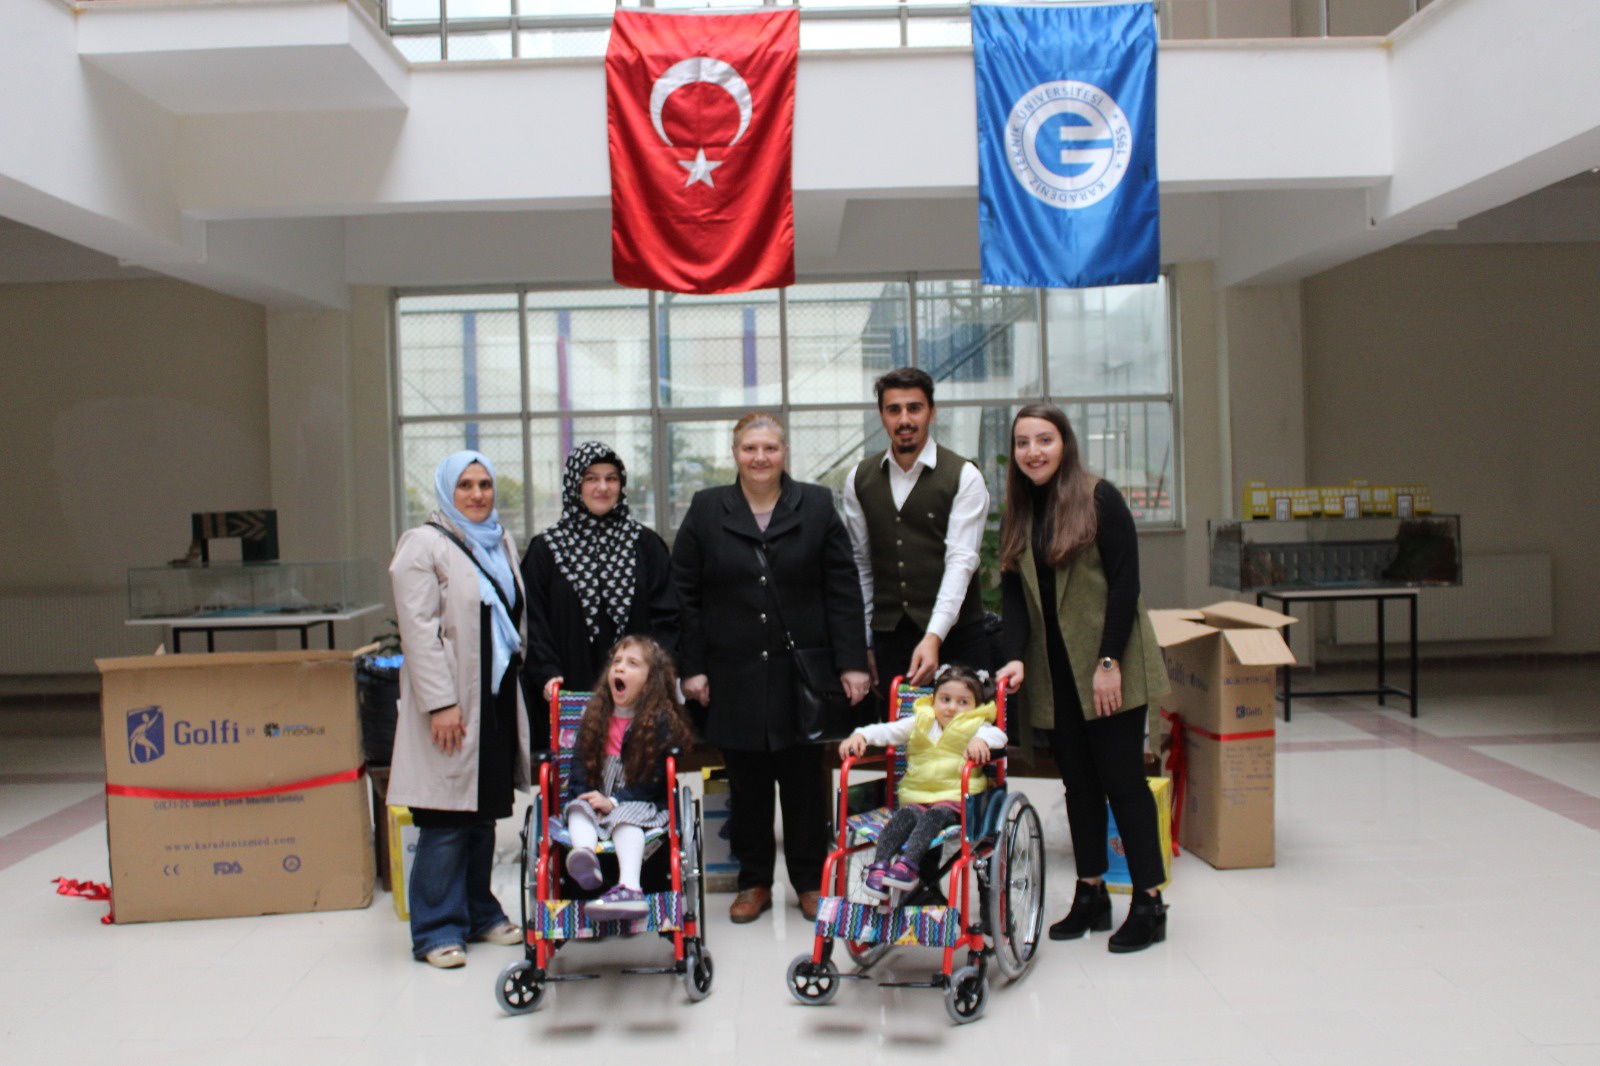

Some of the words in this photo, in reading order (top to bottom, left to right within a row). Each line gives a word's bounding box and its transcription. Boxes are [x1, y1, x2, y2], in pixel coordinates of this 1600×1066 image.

[1115, 126, 1128, 155] 1955
[173, 719, 240, 746] Golfi
[213, 861, 243, 875] FDA
